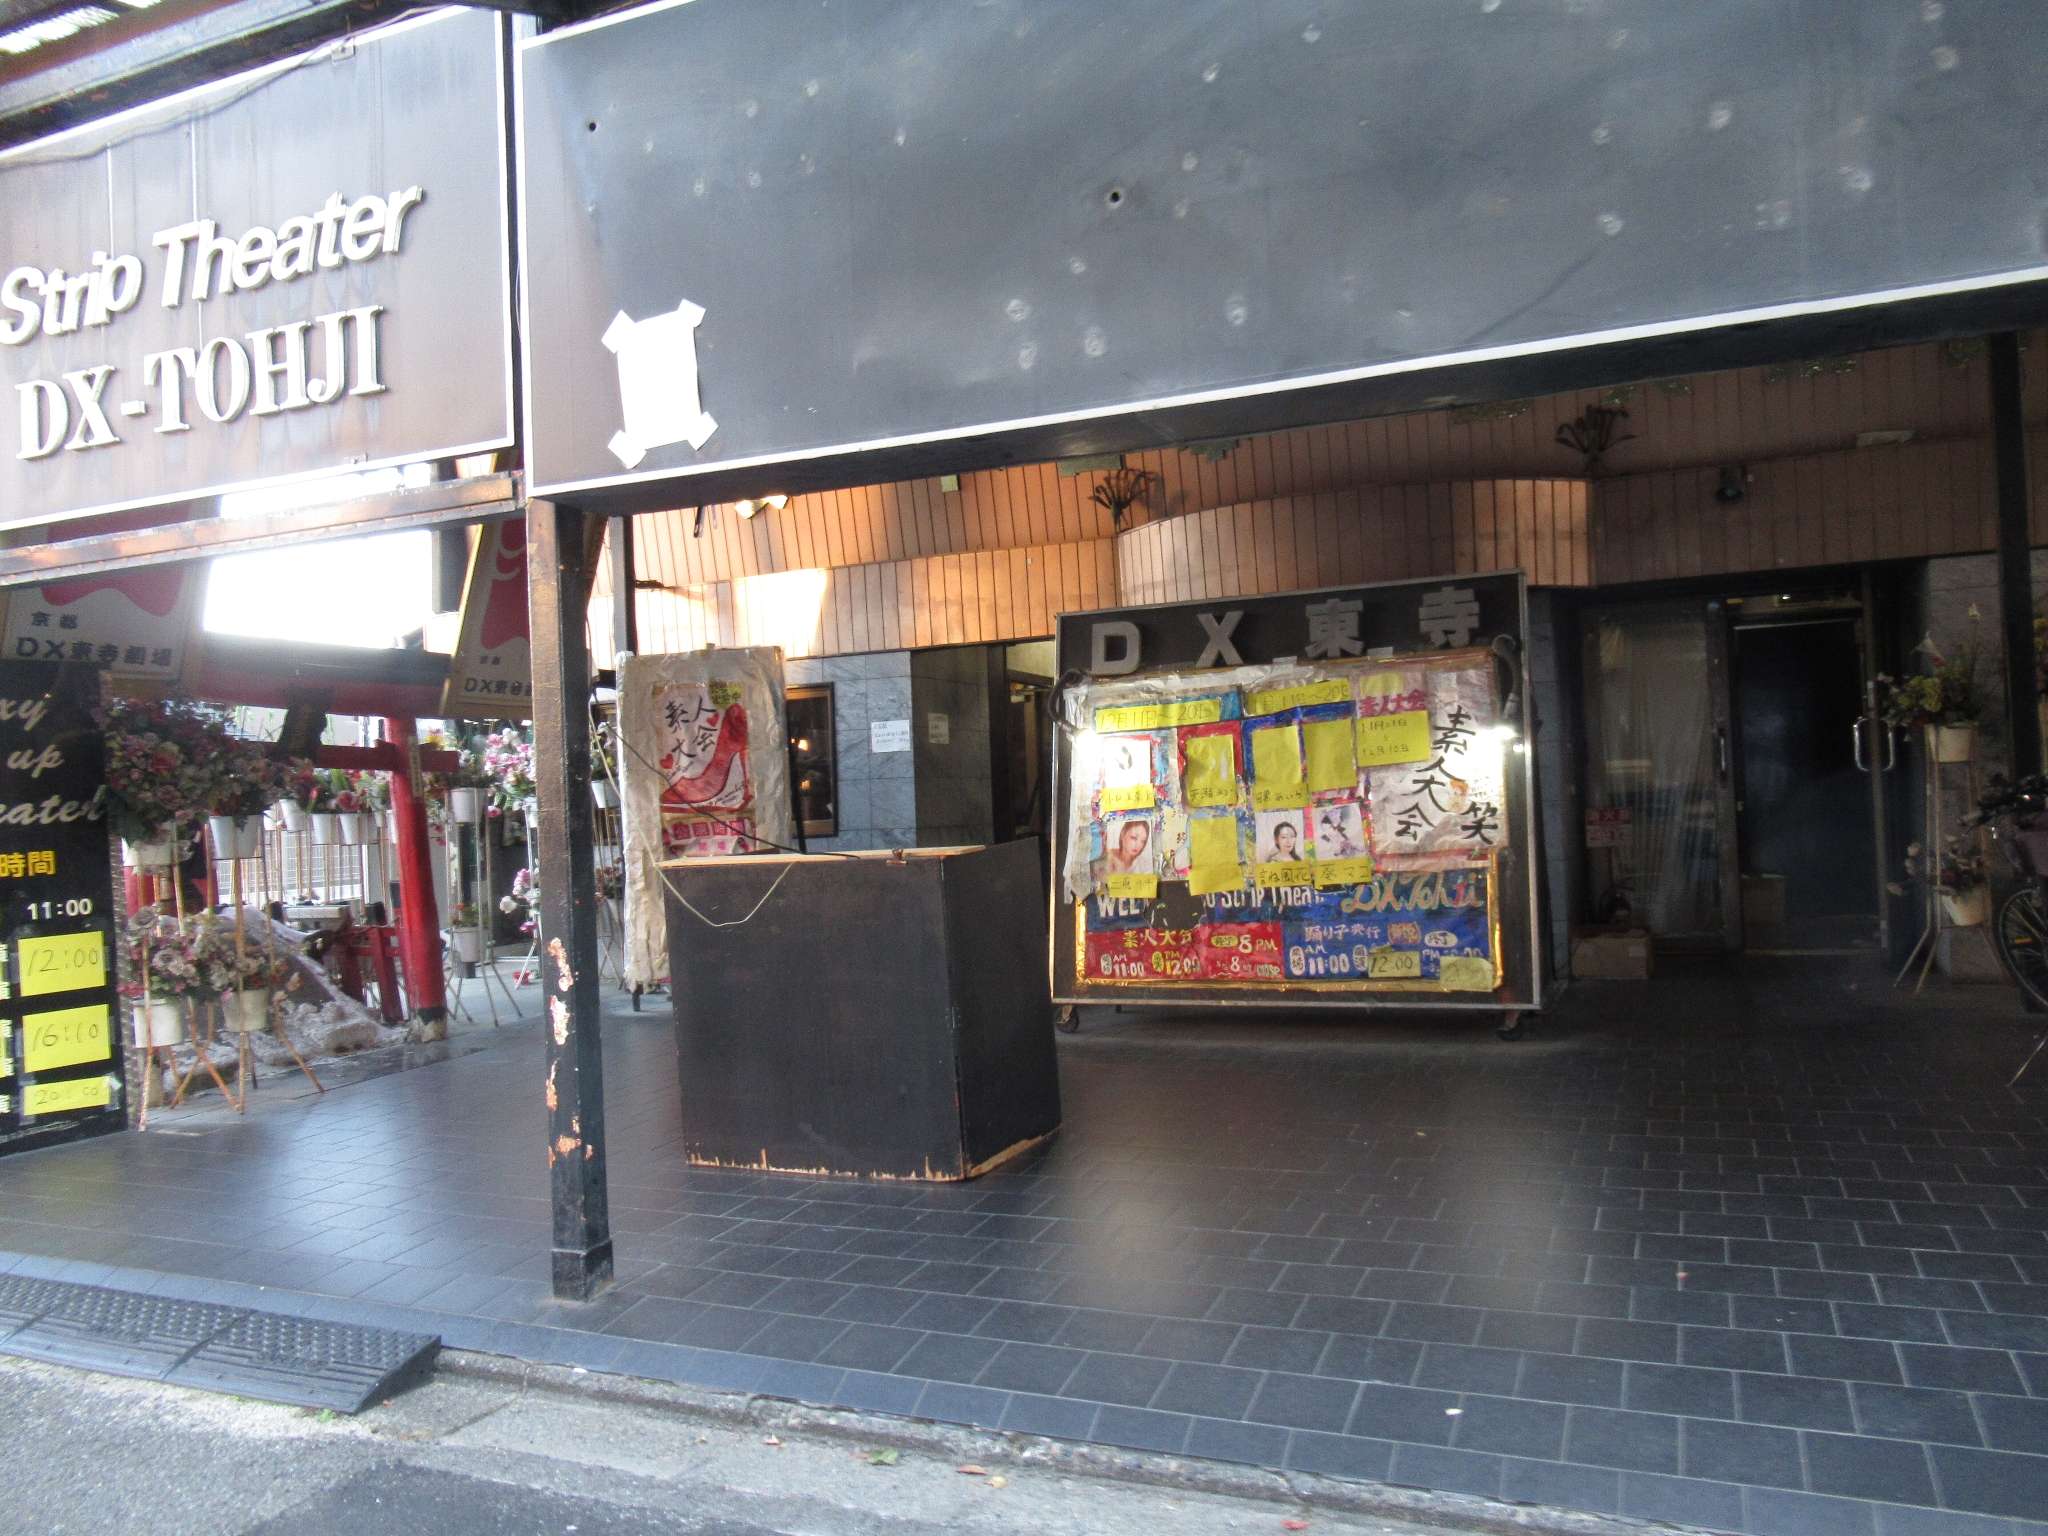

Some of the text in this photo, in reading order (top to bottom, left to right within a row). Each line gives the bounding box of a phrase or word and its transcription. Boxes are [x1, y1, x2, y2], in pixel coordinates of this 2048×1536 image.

[0, 185, 425, 345] Strip Theater
[15, 305, 388, 461] DX-TOHJI
[7, 743, 65, 779] up
[27, 898, 94, 920] 11:00
[28, 948, 99, 977] 12:00
[1305, 944, 1328, 954] AM
[1308, 953, 1350, 976] 11:00
[33, 1022, 99, 1052] 16:10
